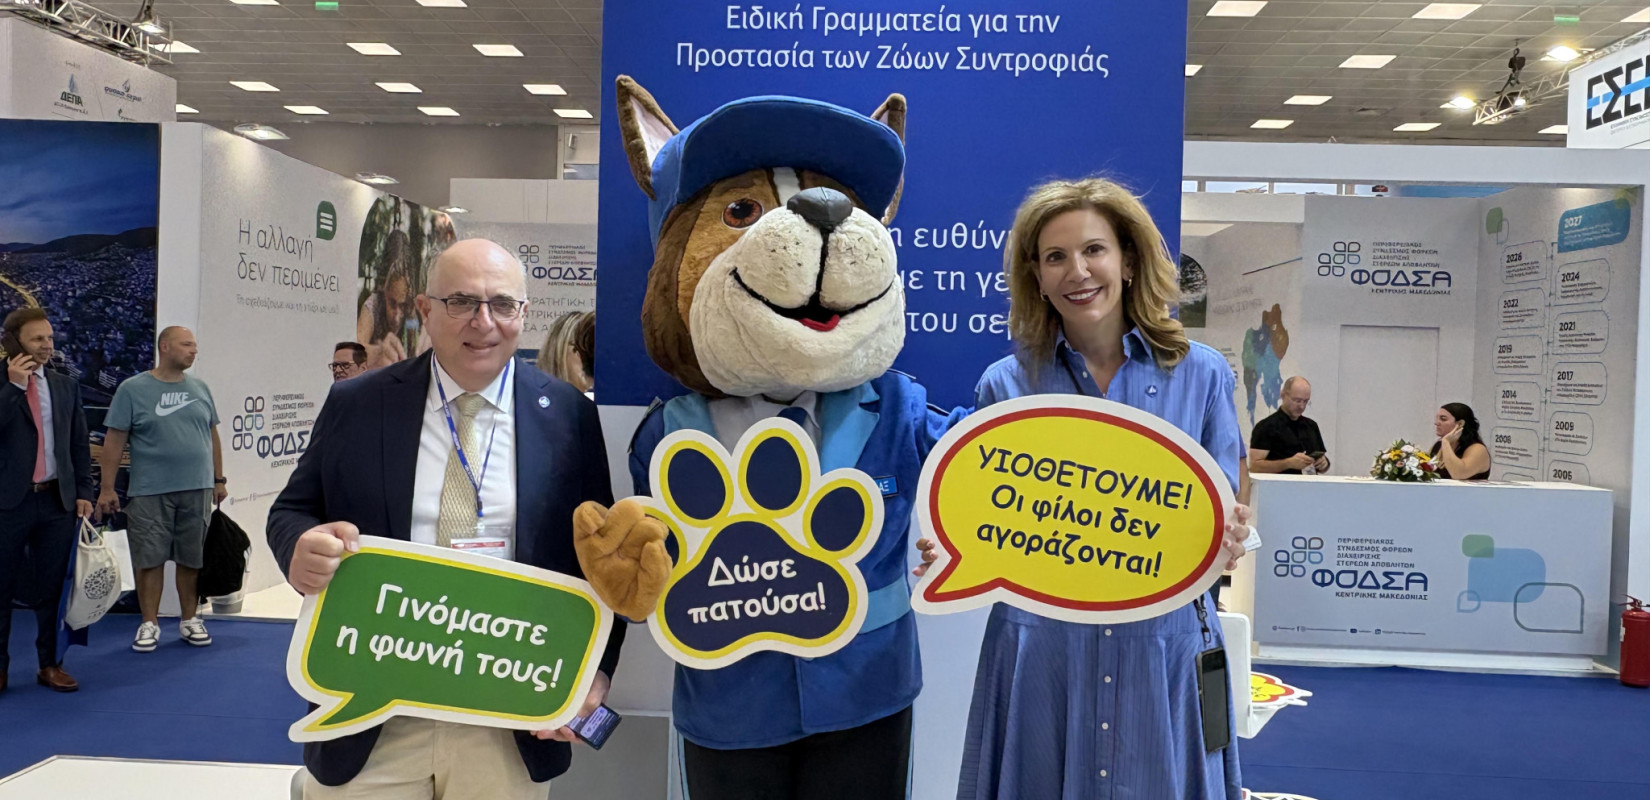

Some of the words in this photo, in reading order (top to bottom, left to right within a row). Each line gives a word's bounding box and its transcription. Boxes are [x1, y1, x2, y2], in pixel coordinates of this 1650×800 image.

[727, 3, 804, 30] Ειδική
[812, 5, 962, 37] Γραμματεία
[969, 12, 1008, 38] για
[1015, 13, 1061, 33] την
[677, 41, 815, 72] Προστασία
[822, 49, 870, 68] των
[876, 42, 949, 71] Ζώων
[956, 45, 1109, 78] Συντροφιάς
[238, 218, 251, 245] Η
[257, 224, 314, 263] αλλαγή
[913, 220, 1012, 250] ευθύν
[237, 252, 267, 282] δεν
[272, 265, 340, 293] περιμένει
[933, 270, 966, 291] τη
[975, 271, 1011, 298] γε
[1351, 269, 1452, 287] ΦΟΔΣΑ
[1561, 271, 1580, 283] 2024
[527, 297, 585, 307] ΡΑΤΗΓΙΚΗ
[906, 312, 958, 333] του
[1559, 321, 1576, 332] 2021
[1557, 371, 1574, 381] 2017
[160, 391, 190, 406] NIKE
[1502, 389, 1517, 399] 2014
[1555, 421, 1575, 431] 2009
[257, 430, 310, 459] ΦΟΔΣ
[979, 444, 1193, 510] ΥΙΟΘΕΤΟΥΜΕ!
[991, 484, 1024, 512] Οι
[1032, 495, 1102, 528] φίλοι
[1110, 507, 1161, 540] δεν
[977, 523, 1163, 578] αγοράζονται!
[1337, 545, 1380, 553] ΣΥΝΔΕΣΜΟΣ
[707, 555, 797, 587] Δώσε
[1311, 568, 1428, 592] ΦΟΔΣΑ
[687, 582, 827, 624] πατούσα!
[1335, 591, 1377, 599] ΚΕΝΤΡΙΚΗΣ
[1379, 592, 1428, 600] ΜΑΚΕΔΟΝΙΑΣ
[376, 583, 548, 646] Γινόμαστε
[336, 625, 358, 655] η
[369, 633, 465, 675] φωνή
[477, 652, 563, 692] τους!
